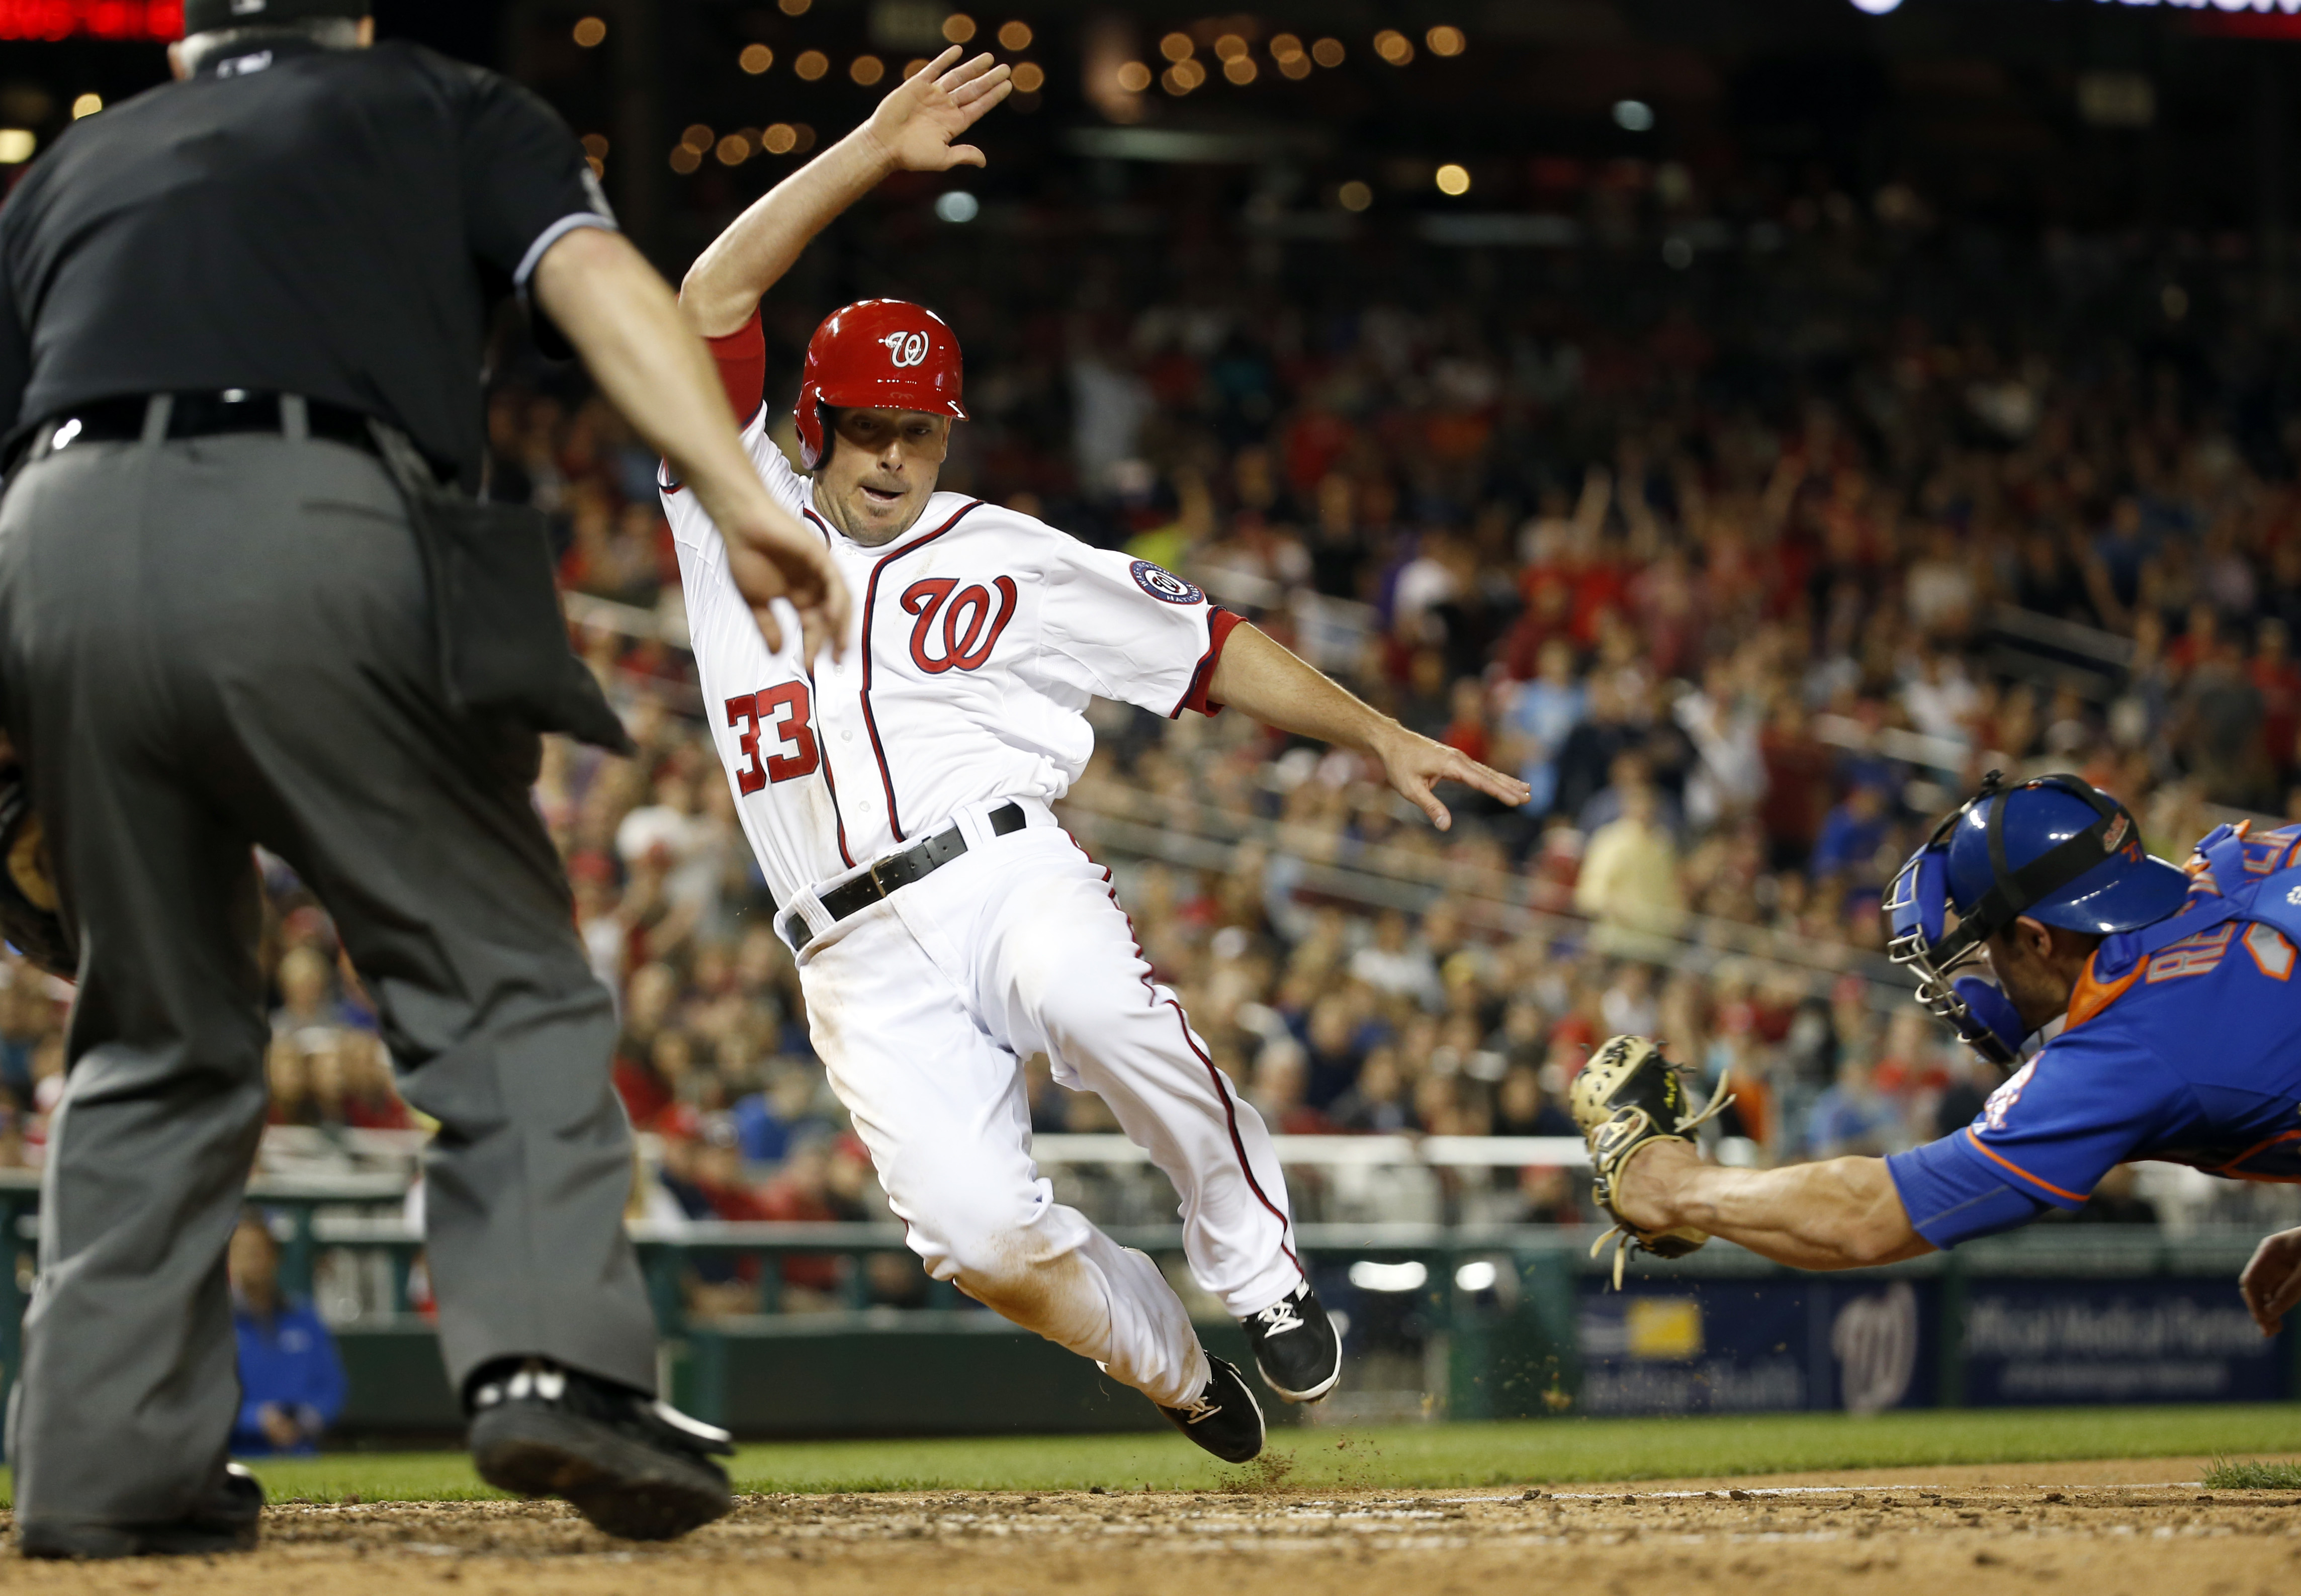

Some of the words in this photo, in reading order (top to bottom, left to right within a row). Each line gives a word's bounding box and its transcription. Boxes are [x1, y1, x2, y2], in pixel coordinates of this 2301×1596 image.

[886, 330, 929, 368] W
[900, 575, 1017, 674] W
[725, 680, 820, 797] 33
